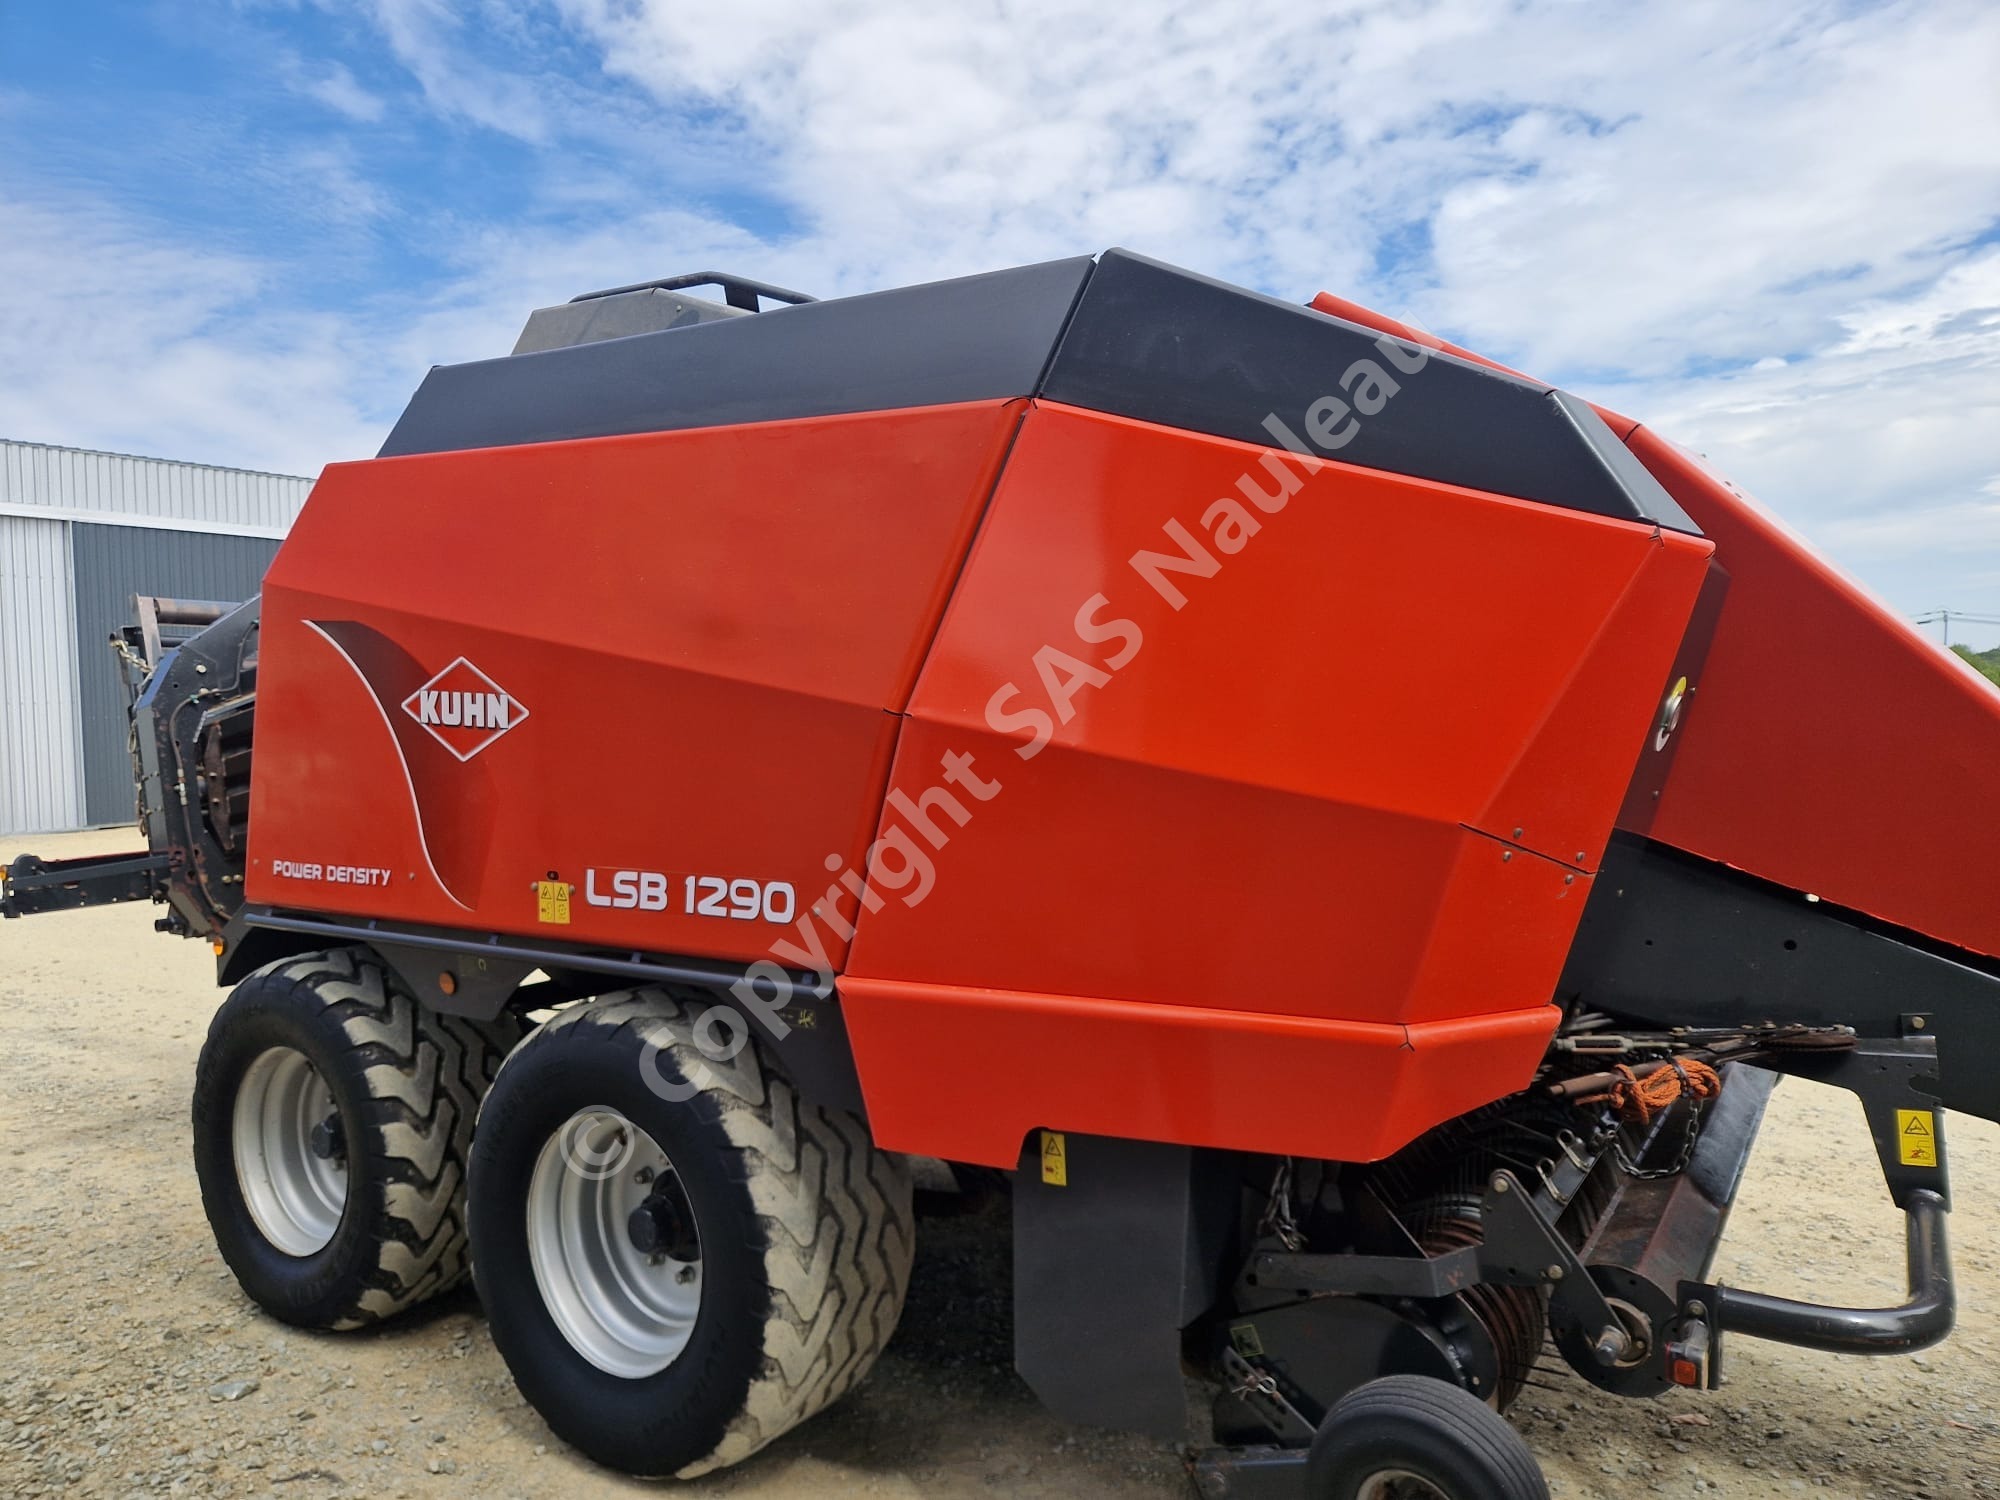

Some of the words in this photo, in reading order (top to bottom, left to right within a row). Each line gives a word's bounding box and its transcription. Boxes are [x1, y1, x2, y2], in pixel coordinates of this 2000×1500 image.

[419, 690, 509, 729] KUHN
[273, 860, 322, 881] POWER
[326, 864, 392, 886] DENSITY
[586, 868, 668, 911] LSB
[684, 875, 796, 924] 1290
